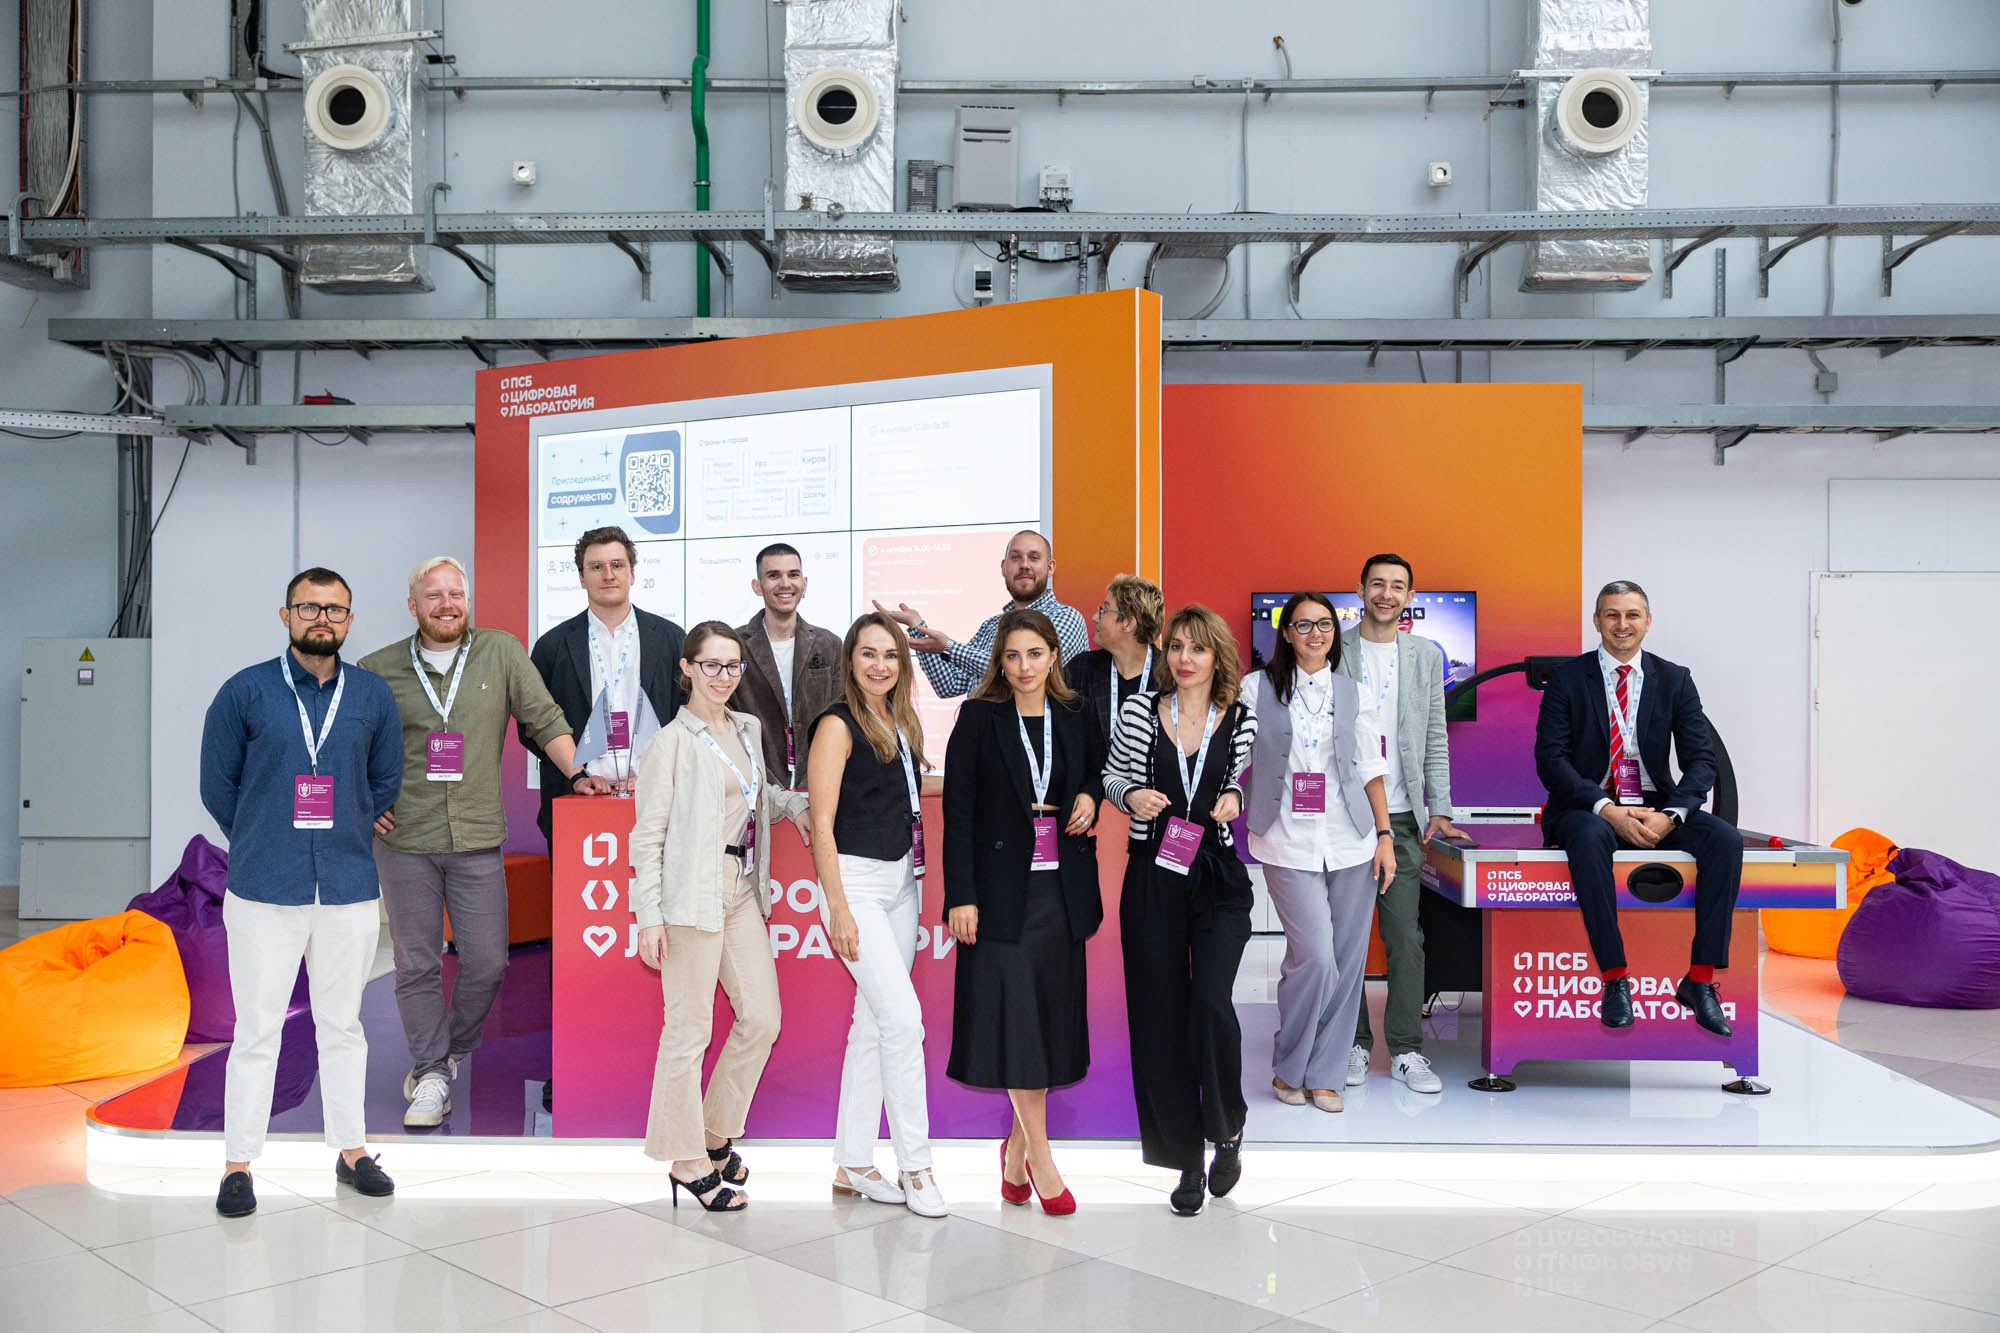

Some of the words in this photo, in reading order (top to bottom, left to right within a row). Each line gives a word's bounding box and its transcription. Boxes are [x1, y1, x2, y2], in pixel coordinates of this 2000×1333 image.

[510, 376, 532, 389] ПСБ
[510, 384, 577, 404] ЦИФРОВАЯ
[509, 396, 595, 417] ЛАБОРАТОРИЯ
[551, 492, 613, 505] содружество
[644, 578, 655, 589] 20
[1498, 870, 1522, 880] ПСБ
[1498, 882, 1570, 893] ЦИФРОВАЯ
[1498, 892, 1578, 902] ЛАБОРАТОРИ
[1537, 952, 1588, 971] ПСБ
[1536, 1000, 1736, 1021] ЛАБОАТОРЯ
